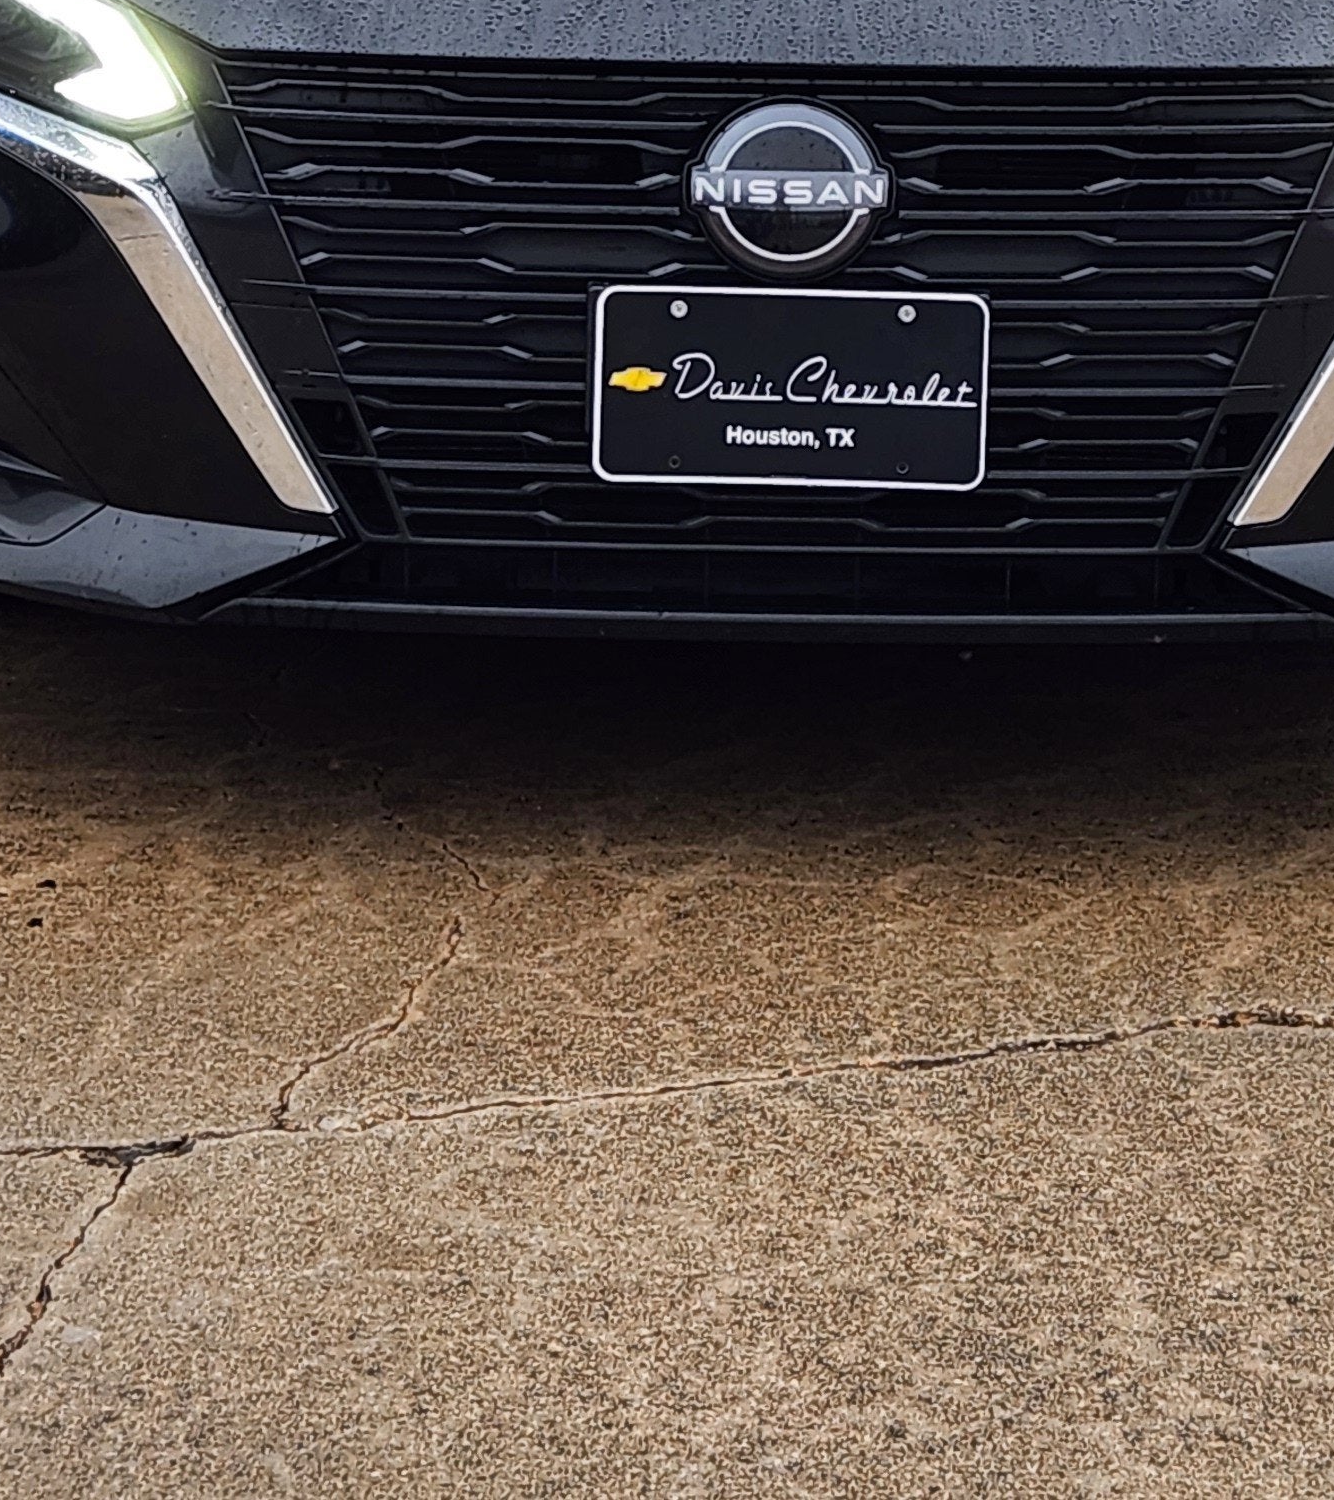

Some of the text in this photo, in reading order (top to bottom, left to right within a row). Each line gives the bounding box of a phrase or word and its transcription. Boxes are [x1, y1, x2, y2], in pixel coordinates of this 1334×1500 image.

[694, 177, 884, 205] NISSAN
[672, 352, 978, 407] Davis Chevrolet
[726, 425, 856, 450] Houston, TX
